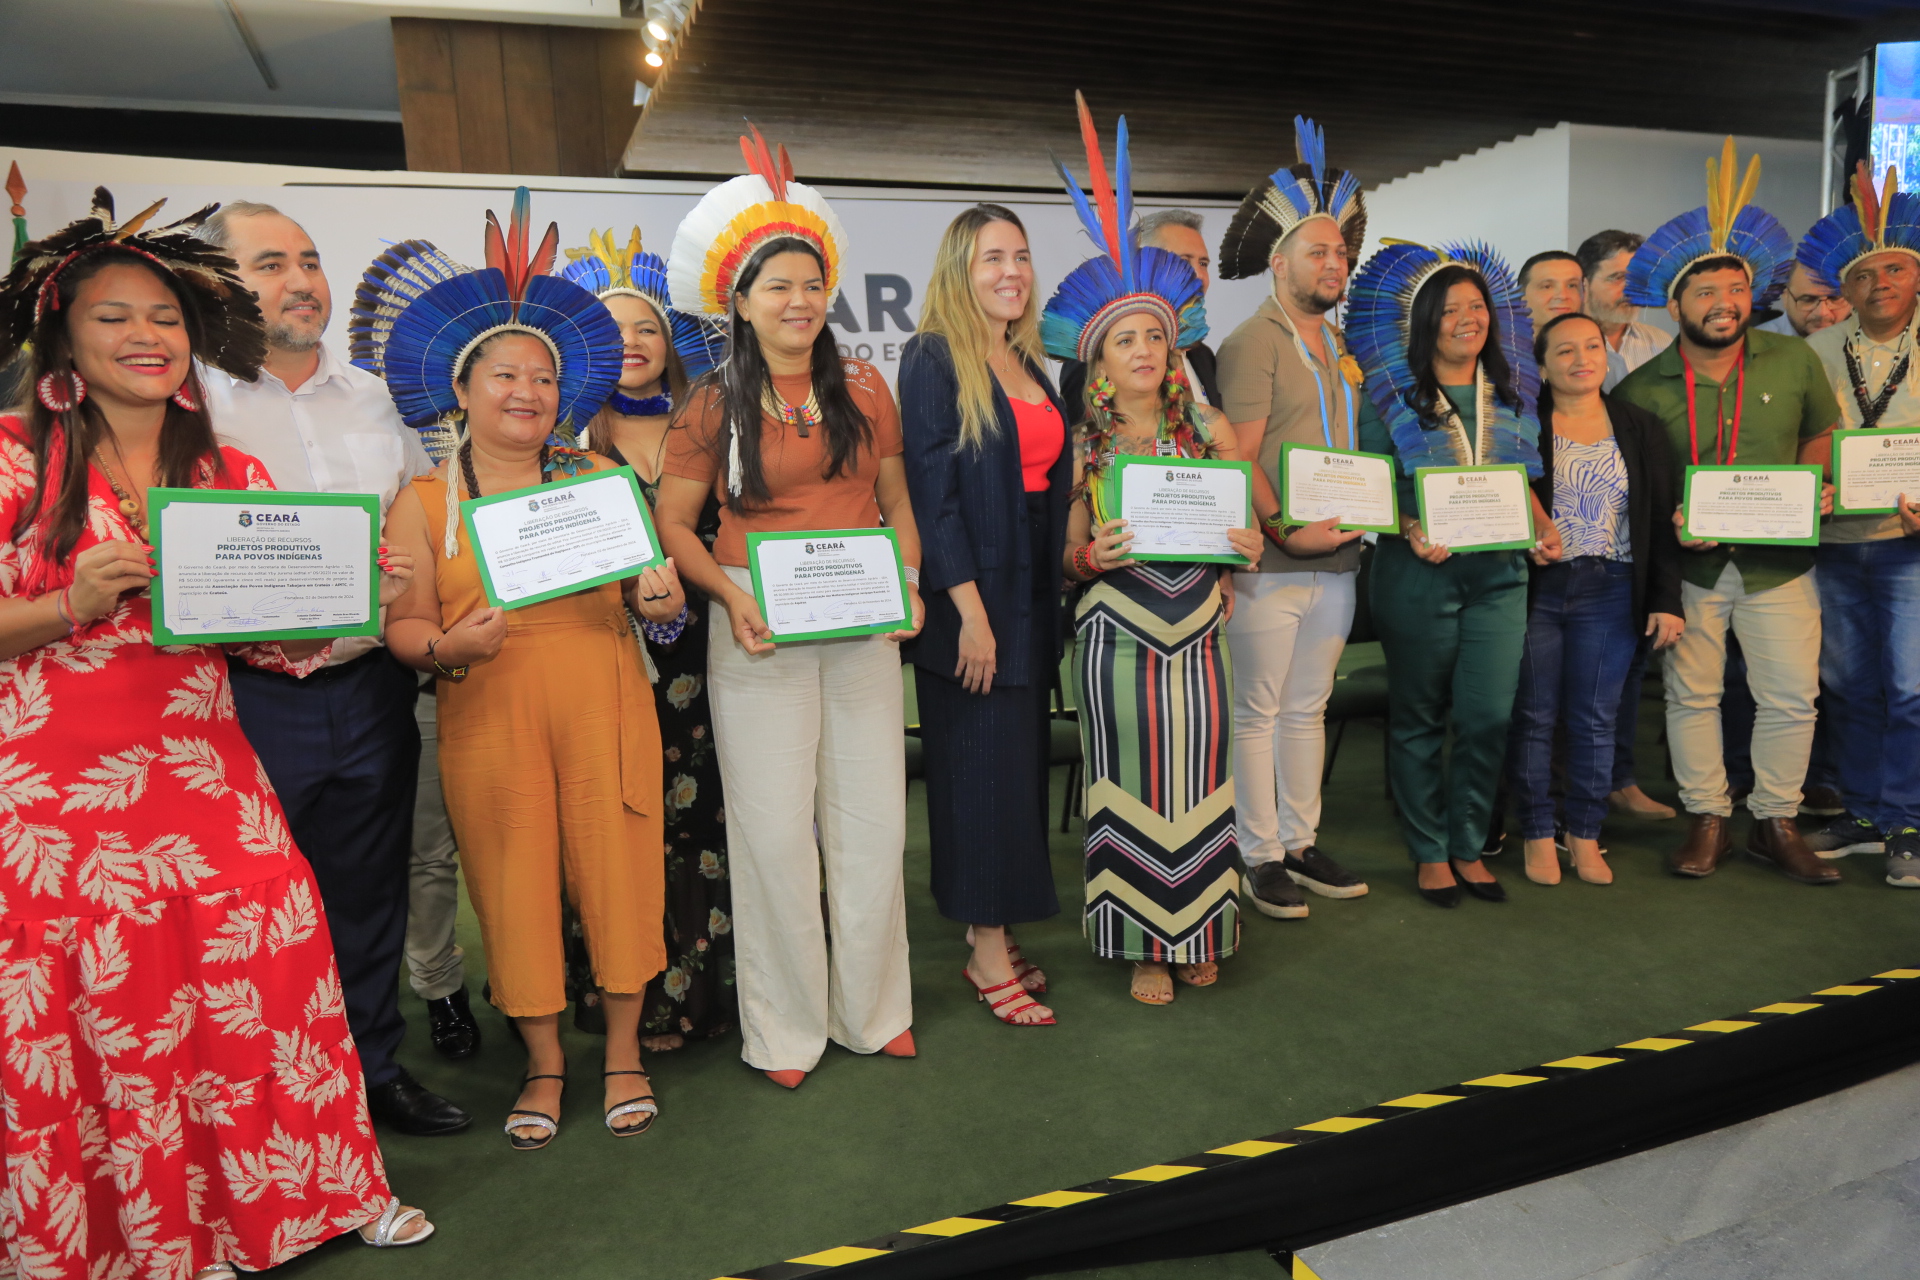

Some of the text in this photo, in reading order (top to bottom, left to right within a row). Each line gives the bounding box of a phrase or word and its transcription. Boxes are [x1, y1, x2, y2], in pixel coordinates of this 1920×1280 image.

[541, 491, 575, 505] CEARÁ
[256, 512, 300, 522] CEARÁ
[518, 510, 597, 534] PROJETOS PRODUTIVOS
[519, 532, 539, 540] PARA
[540, 525, 564, 535] POVOS
[565, 516, 601, 529] INDÍGENAS
[816, 541, 845, 550] CEARÁ
[277, 552, 322, 560] INDÍGENAS
